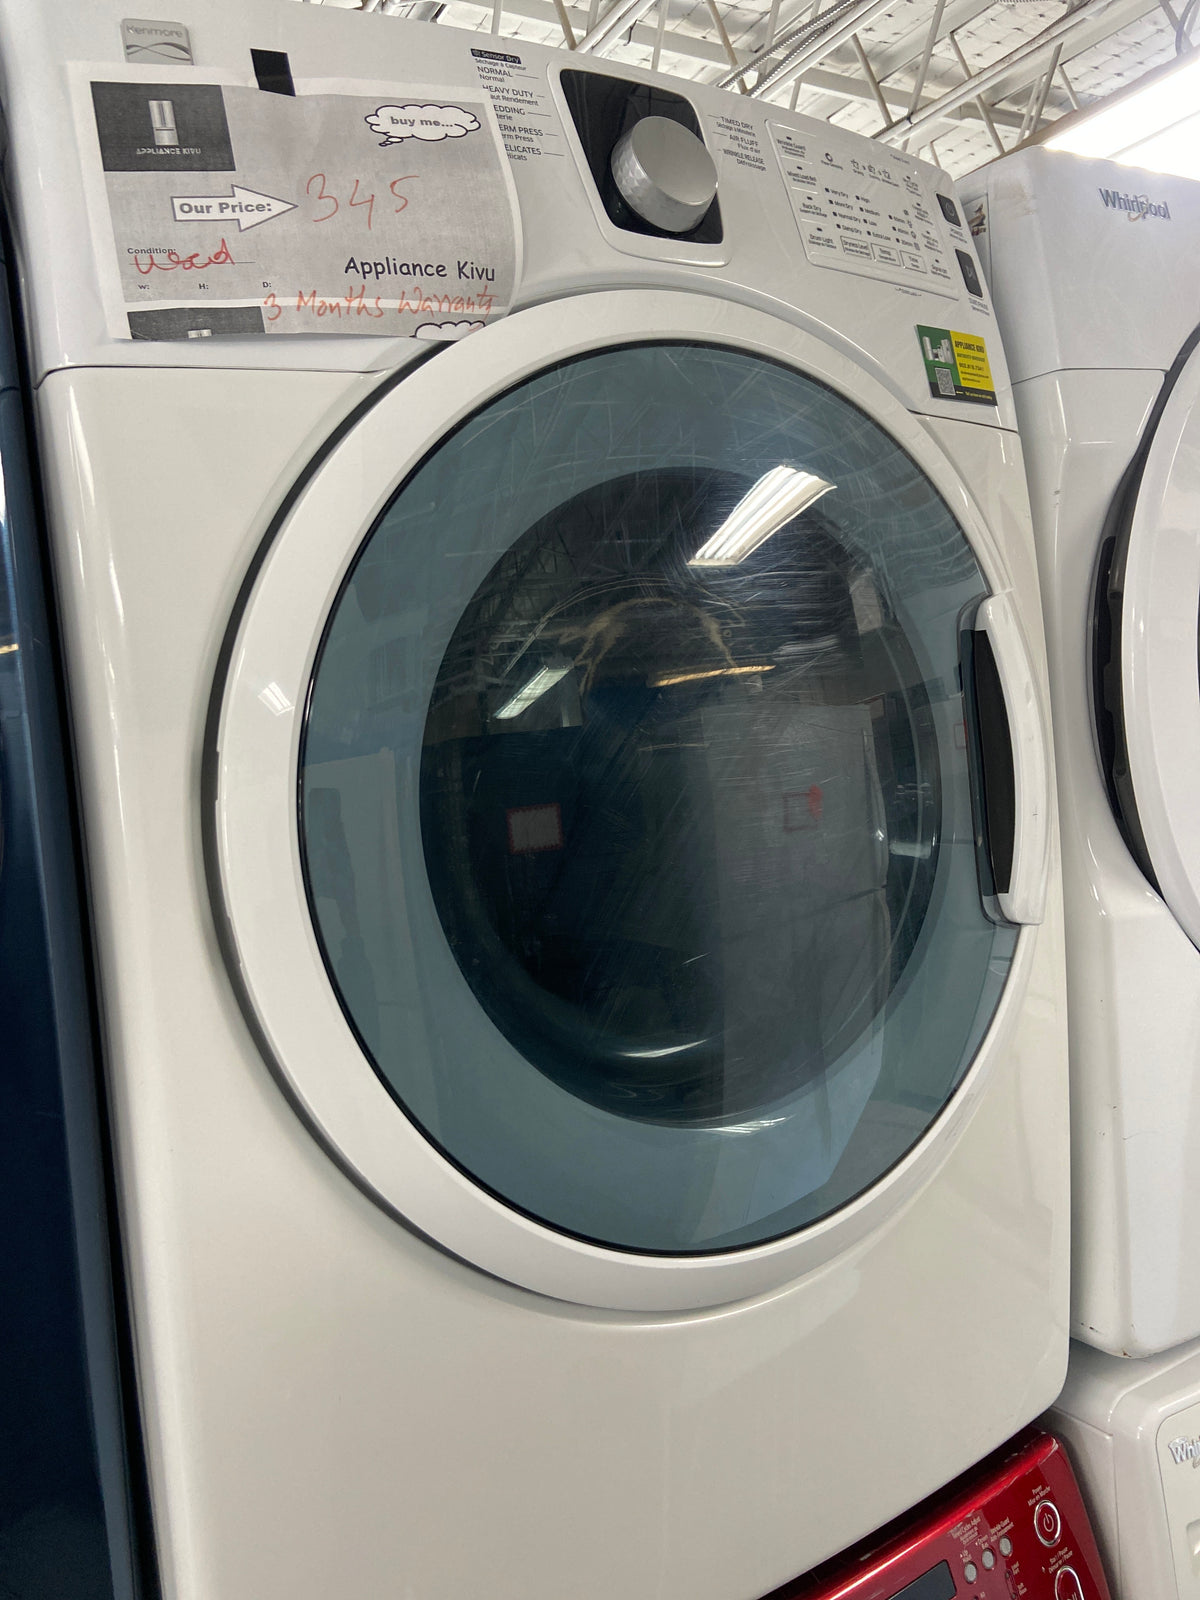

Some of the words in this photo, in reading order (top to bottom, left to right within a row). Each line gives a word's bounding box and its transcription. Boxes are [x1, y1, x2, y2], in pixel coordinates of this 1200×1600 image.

[125, 24, 184, 38] Kenmore
[477, 66, 513, 77] NORMAL
[480, 74, 505, 82] Normal
[512, 88, 534, 98] DUTY
[502, 95, 539, 106] Rendement
[493, 104, 525, 116] EDDING
[390, 116, 416, 127] buy
[499, 124, 516, 133] ERM
[518, 127, 544, 136] PRESS
[515, 134, 534, 142] Press
[504, 144, 542, 155] ELICATES
[306, 173, 420, 231] 345
[1098, 187, 1171, 221] Whirlpool
[179, 202, 212, 214] Our
[218, 202, 273, 214] Price:
[127, 247, 176, 255] Condition:
[344, 256, 448, 281] Appliance
[456, 260, 496, 282] Kivu
[263, 292, 283, 321] 3
[296, 284, 385, 319] Months
